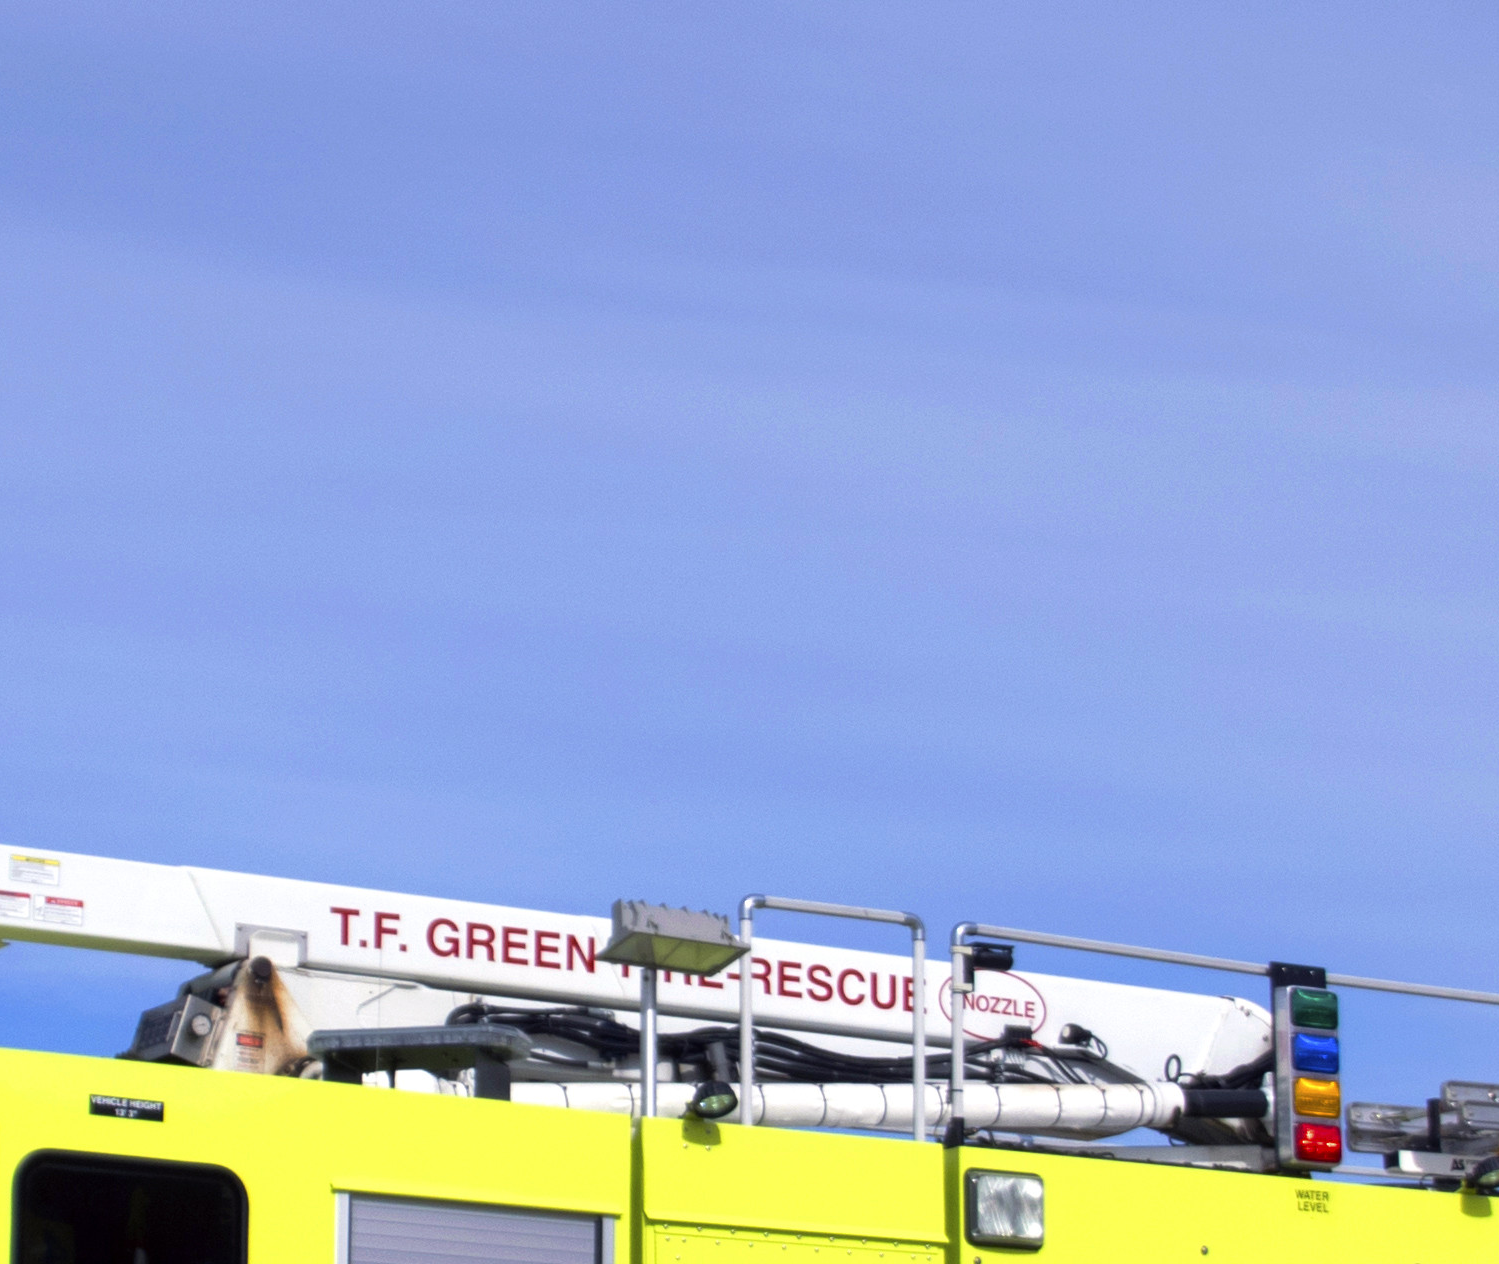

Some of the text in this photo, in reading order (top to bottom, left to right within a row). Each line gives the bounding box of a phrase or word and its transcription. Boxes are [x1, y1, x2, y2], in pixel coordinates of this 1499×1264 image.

[331, 906, 407, 952] T.F.
[427, 918, 595, 974] GREEN
[1295, 1189, 1329, 1201] WATER
[1297, 1201, 1329, 1213] LEVEL
